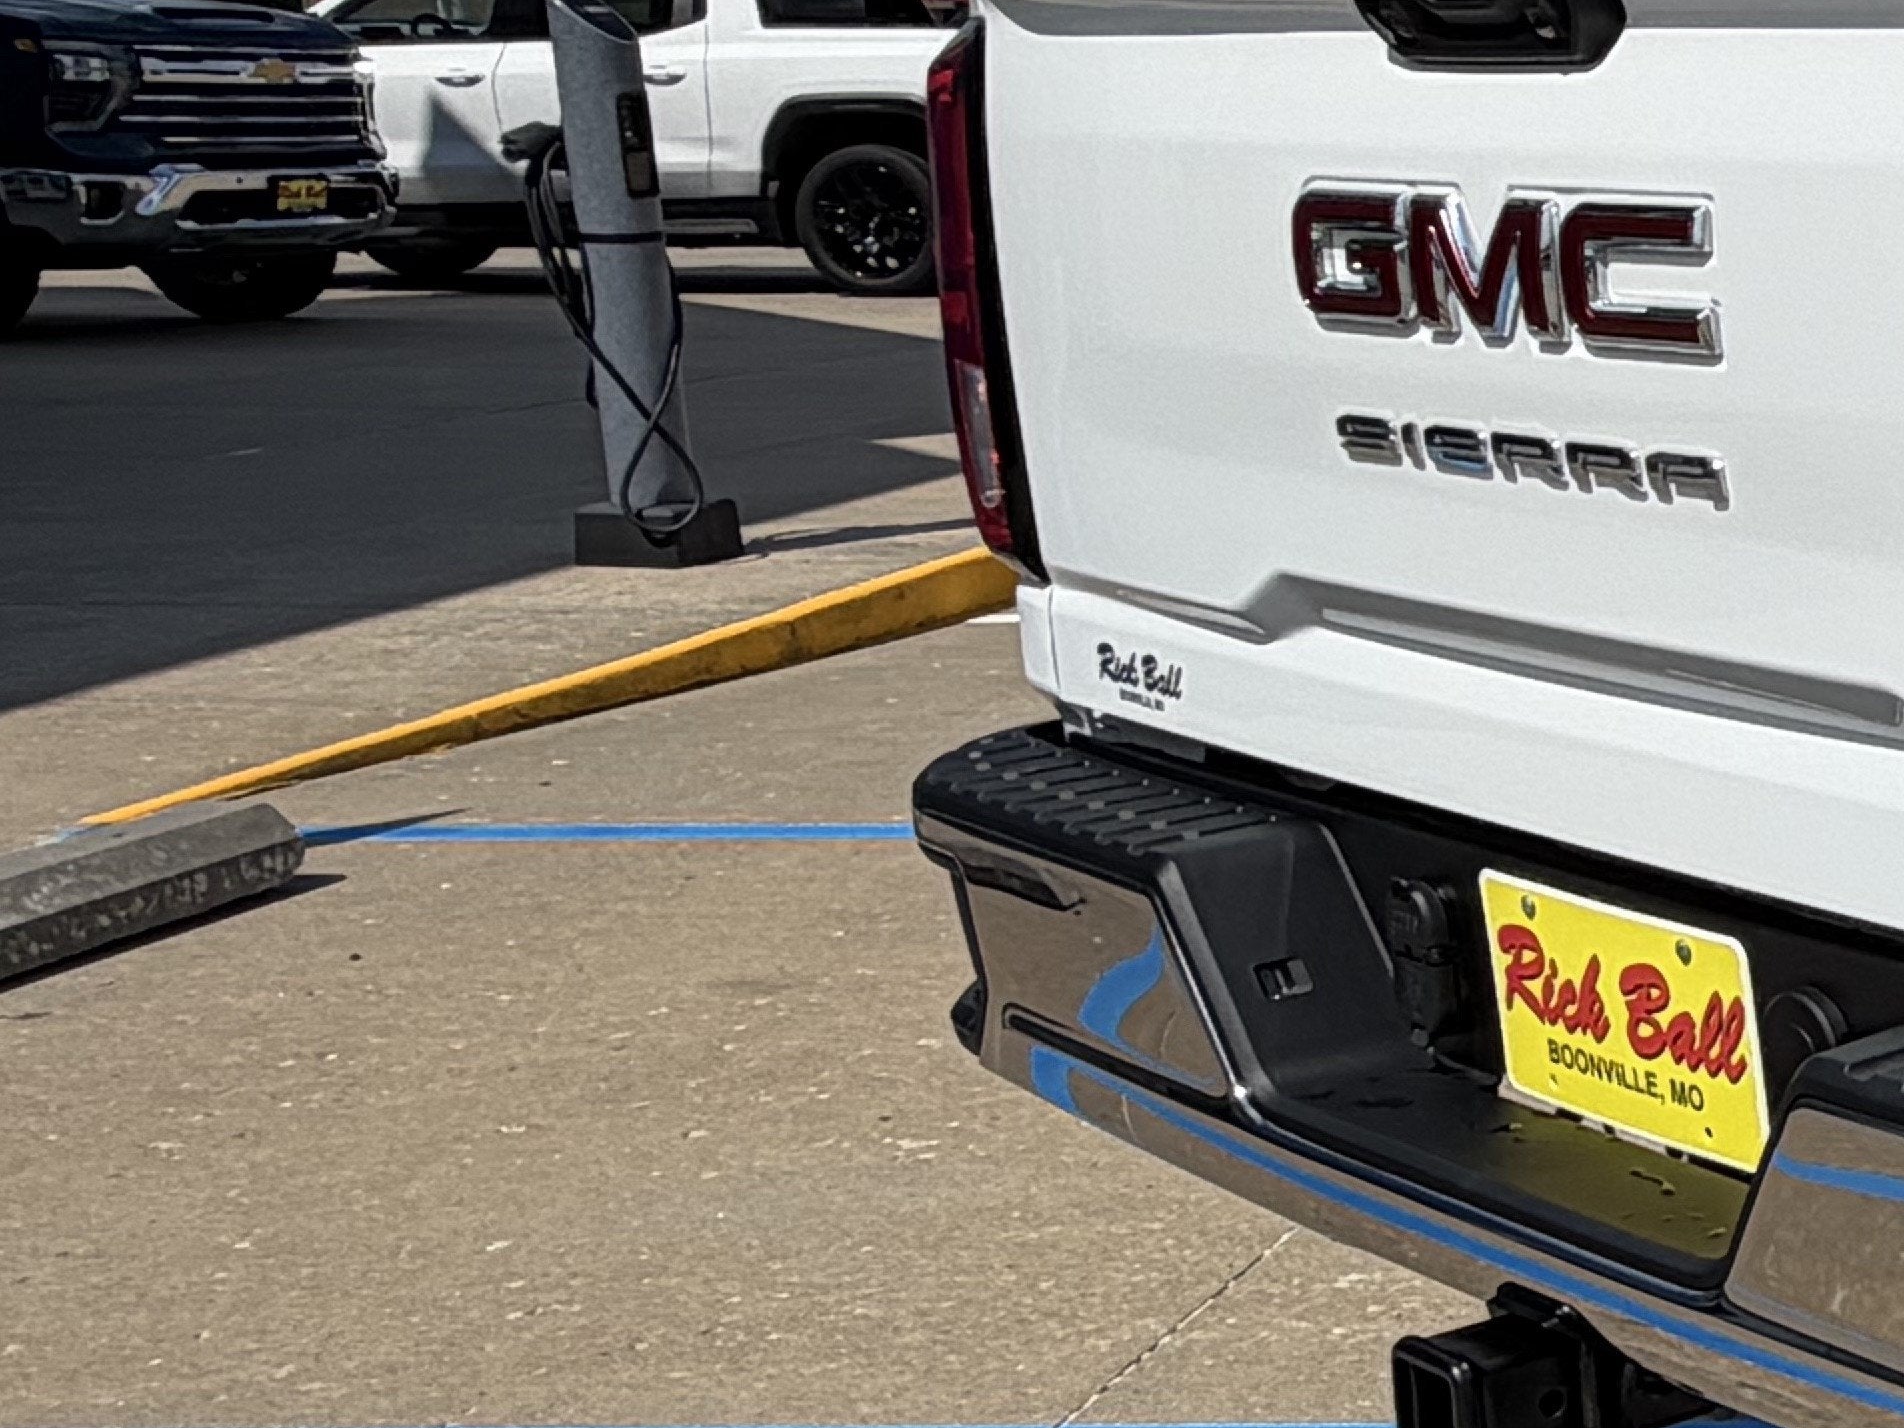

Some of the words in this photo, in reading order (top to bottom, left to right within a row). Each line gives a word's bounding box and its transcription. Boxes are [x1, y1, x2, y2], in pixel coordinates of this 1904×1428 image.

[1293, 175, 1724, 369] GMC
[1334, 413, 1731, 512] SIERRA
[1496, 924, 1612, 1044] Rick
[1619, 962, 1748, 1085] Ball
[1547, 1038, 1667, 1106] BOONVILLE,
[1669, 1078, 1705, 1113] MO
